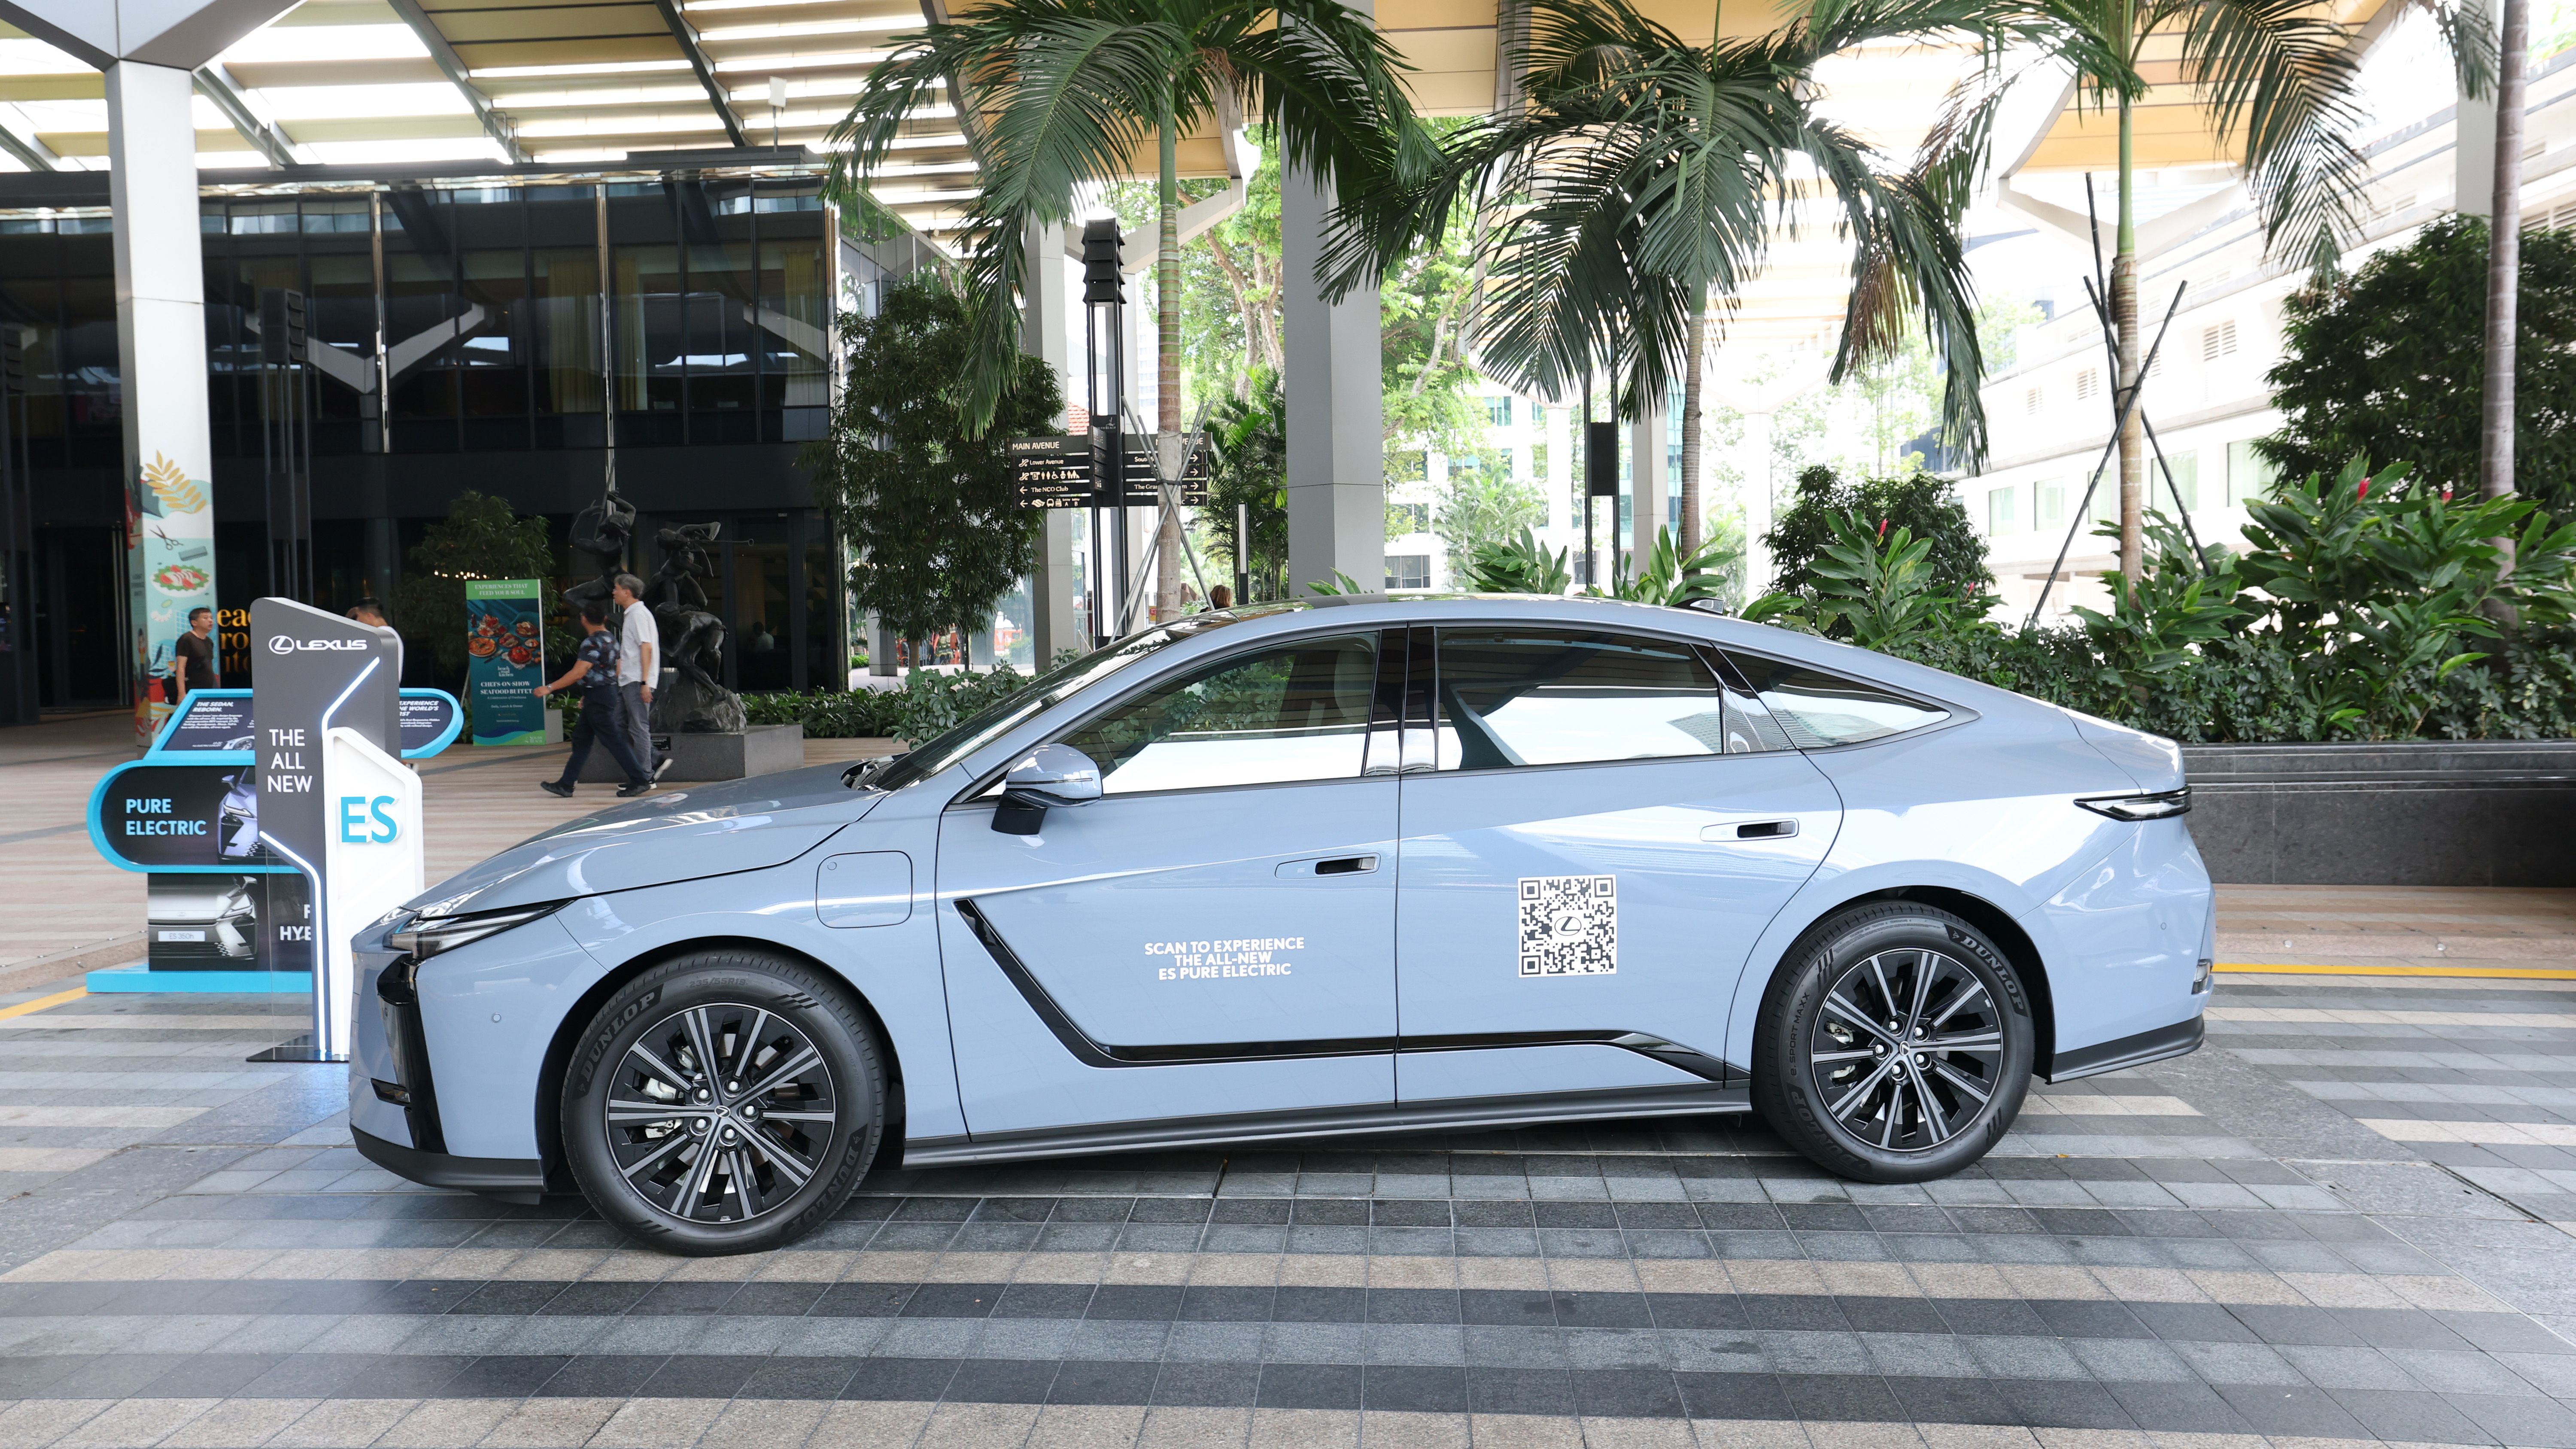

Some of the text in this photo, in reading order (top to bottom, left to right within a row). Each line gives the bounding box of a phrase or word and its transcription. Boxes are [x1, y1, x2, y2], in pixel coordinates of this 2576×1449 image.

[1032, 441, 1060, 450] AVENUE
[219, 632, 249, 650] ro
[295, 640, 368, 650] LEXUS
[269, 729, 305, 746] THE
[271, 752, 305, 769] ALL
[267, 775, 313, 793] NEW
[126, 799, 171, 813] PURE
[126, 820, 207, 835] ELECTRIC
[341, 796, 397, 843] ES
[1145, 937, 1305, 955] SCAN TO EXPERIENCE
[1174, 951, 1272, 966] THE ALL-NEW
[1159, 963, 1292, 980] ES PURE ELECTRIC
[1960, 936, 2024, 1009] DUNLOP
[689, 977, 746, 987] 235/55R19
[1794, 992, 1810, 1024] MAXX
[581, 992, 654, 1082] DUNLOP
[1791, 1092, 1859, 1163] DUNLOP
[788, 1146, 859, 1236] DUNLOP
